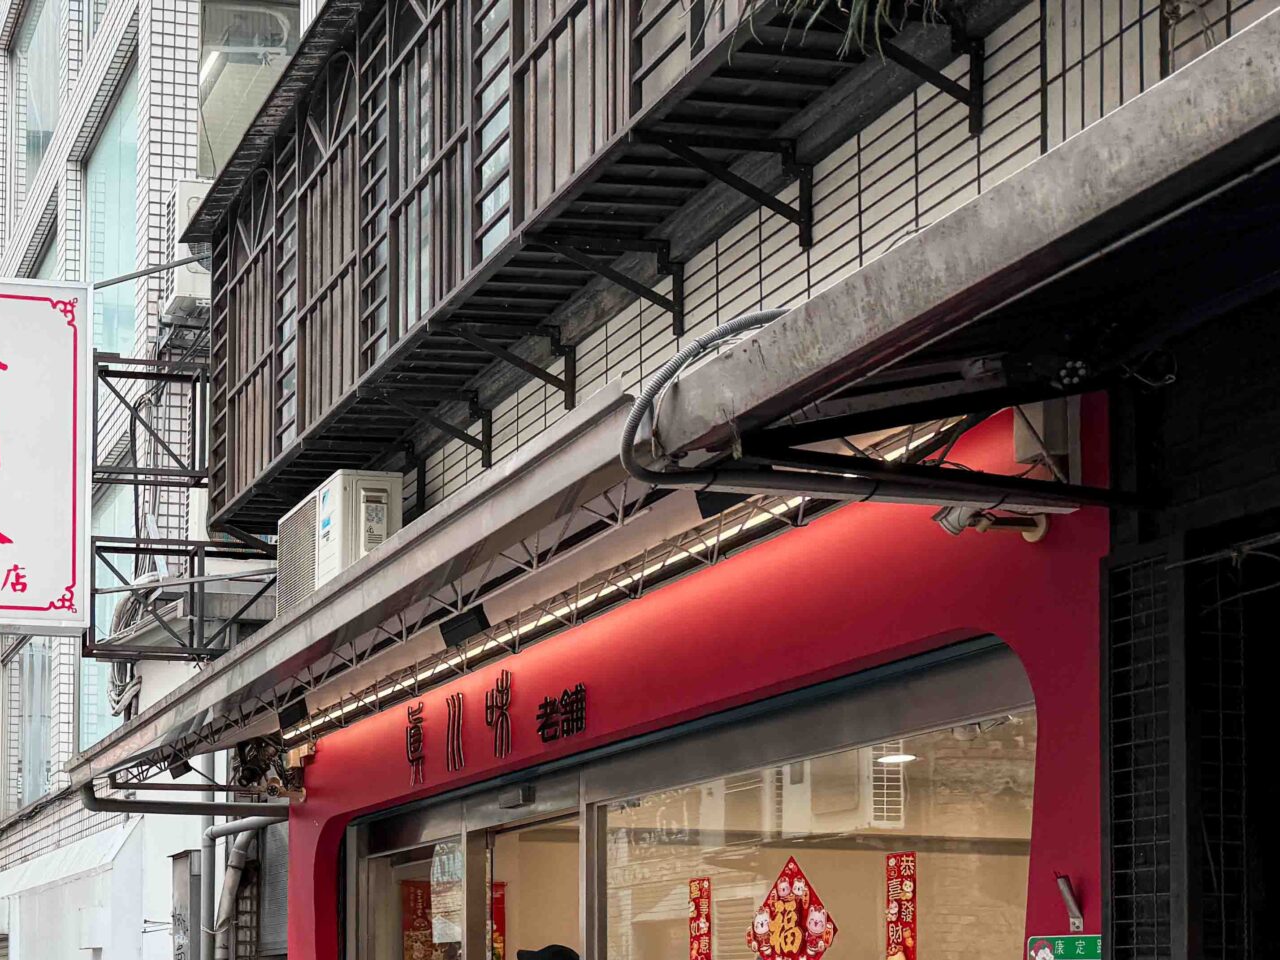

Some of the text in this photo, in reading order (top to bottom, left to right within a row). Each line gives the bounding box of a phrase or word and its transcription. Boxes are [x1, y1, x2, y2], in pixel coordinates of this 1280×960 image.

[769, 899, 803, 955] 福
[887, 854, 916, 945] 恭喜發財
